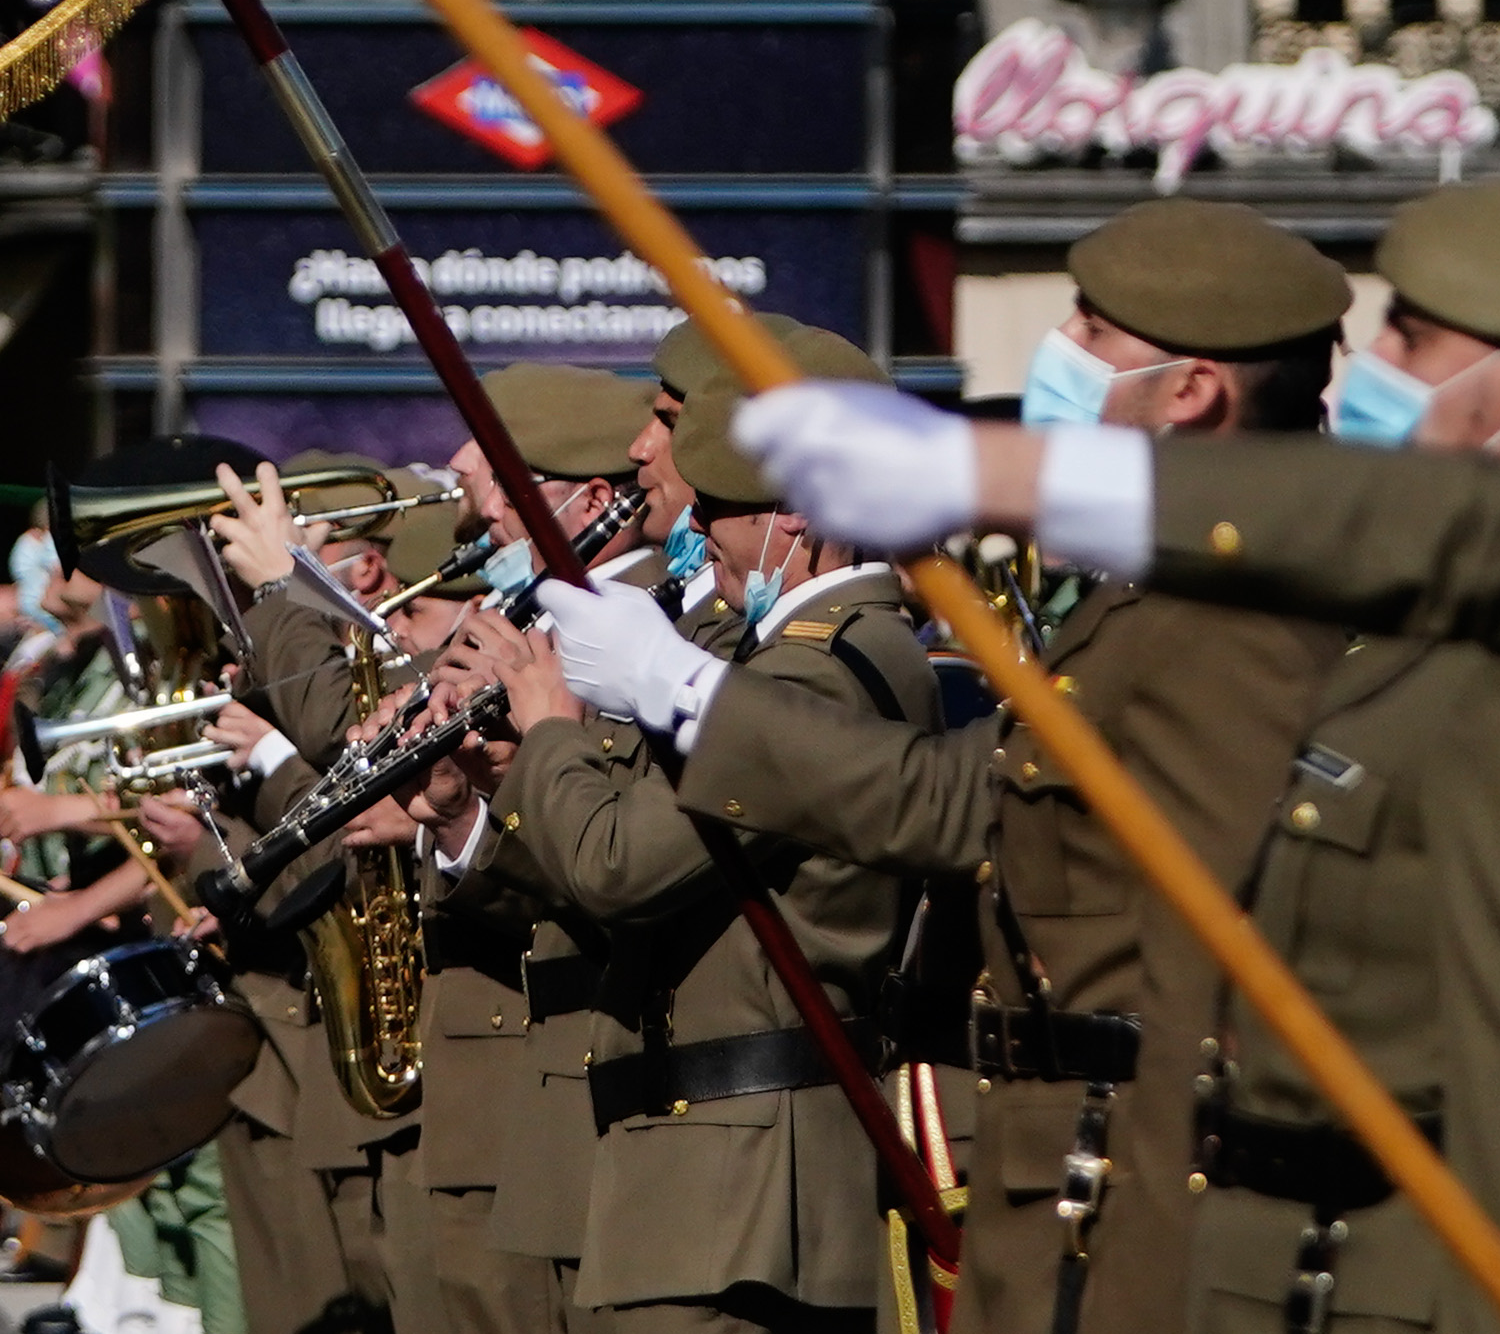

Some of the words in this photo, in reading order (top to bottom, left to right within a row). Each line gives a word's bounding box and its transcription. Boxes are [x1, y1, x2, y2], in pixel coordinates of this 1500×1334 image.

[952, 18, 1499, 194] llorquina
[432, 247, 560, 296] dónde
[559, 249, 767, 302] podros
[315, 297, 432, 351] lleg
[471, 300, 738, 343] conectarn
